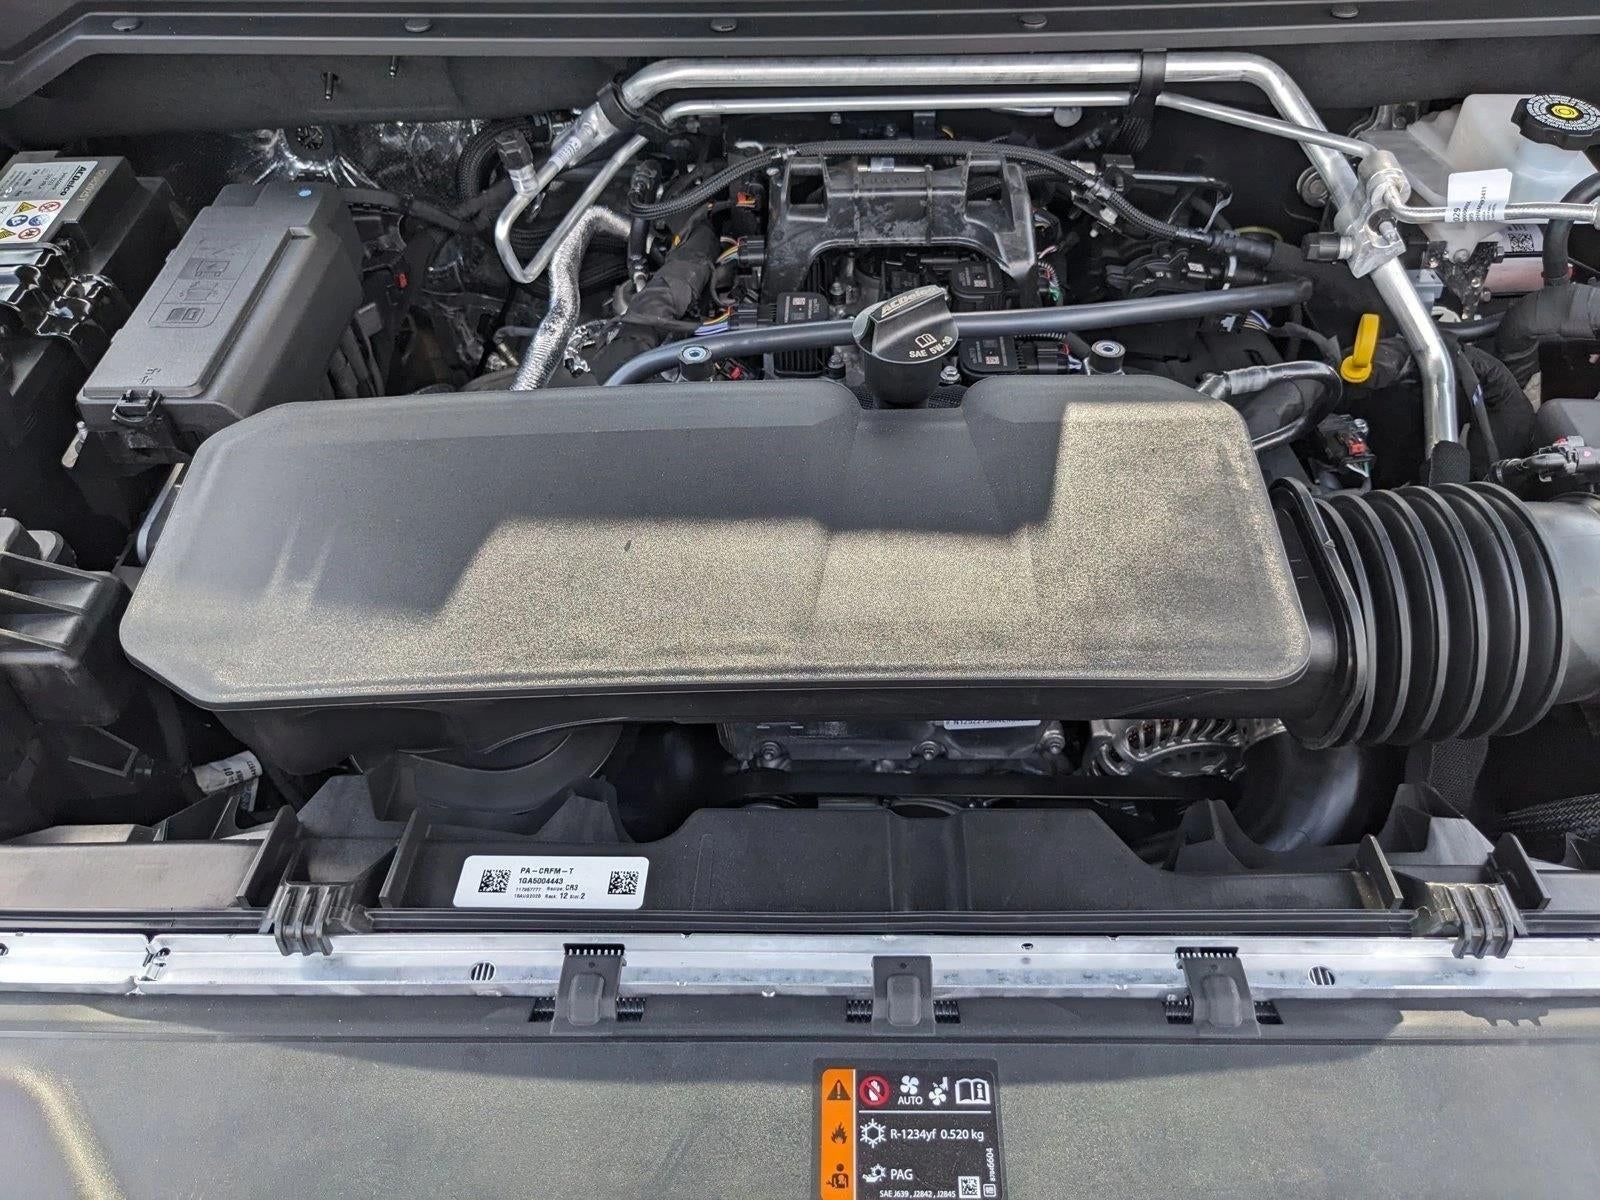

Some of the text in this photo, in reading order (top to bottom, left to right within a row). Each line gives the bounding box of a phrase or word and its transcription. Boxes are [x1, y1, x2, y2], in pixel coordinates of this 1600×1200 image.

[909, 350, 928, 358] SAE
[930, 336, 953, 355] 5W-30
[559, 892, 569, 900] 12
[580, 892, 586, 900] 2
[897, 1096, 923, 1106] AUTO
[890, 1129, 985, 1142] R-1234yf 0.520 kg
[890, 1169, 914, 1180] PAG
[880, 1190, 893, 1198] SAE
